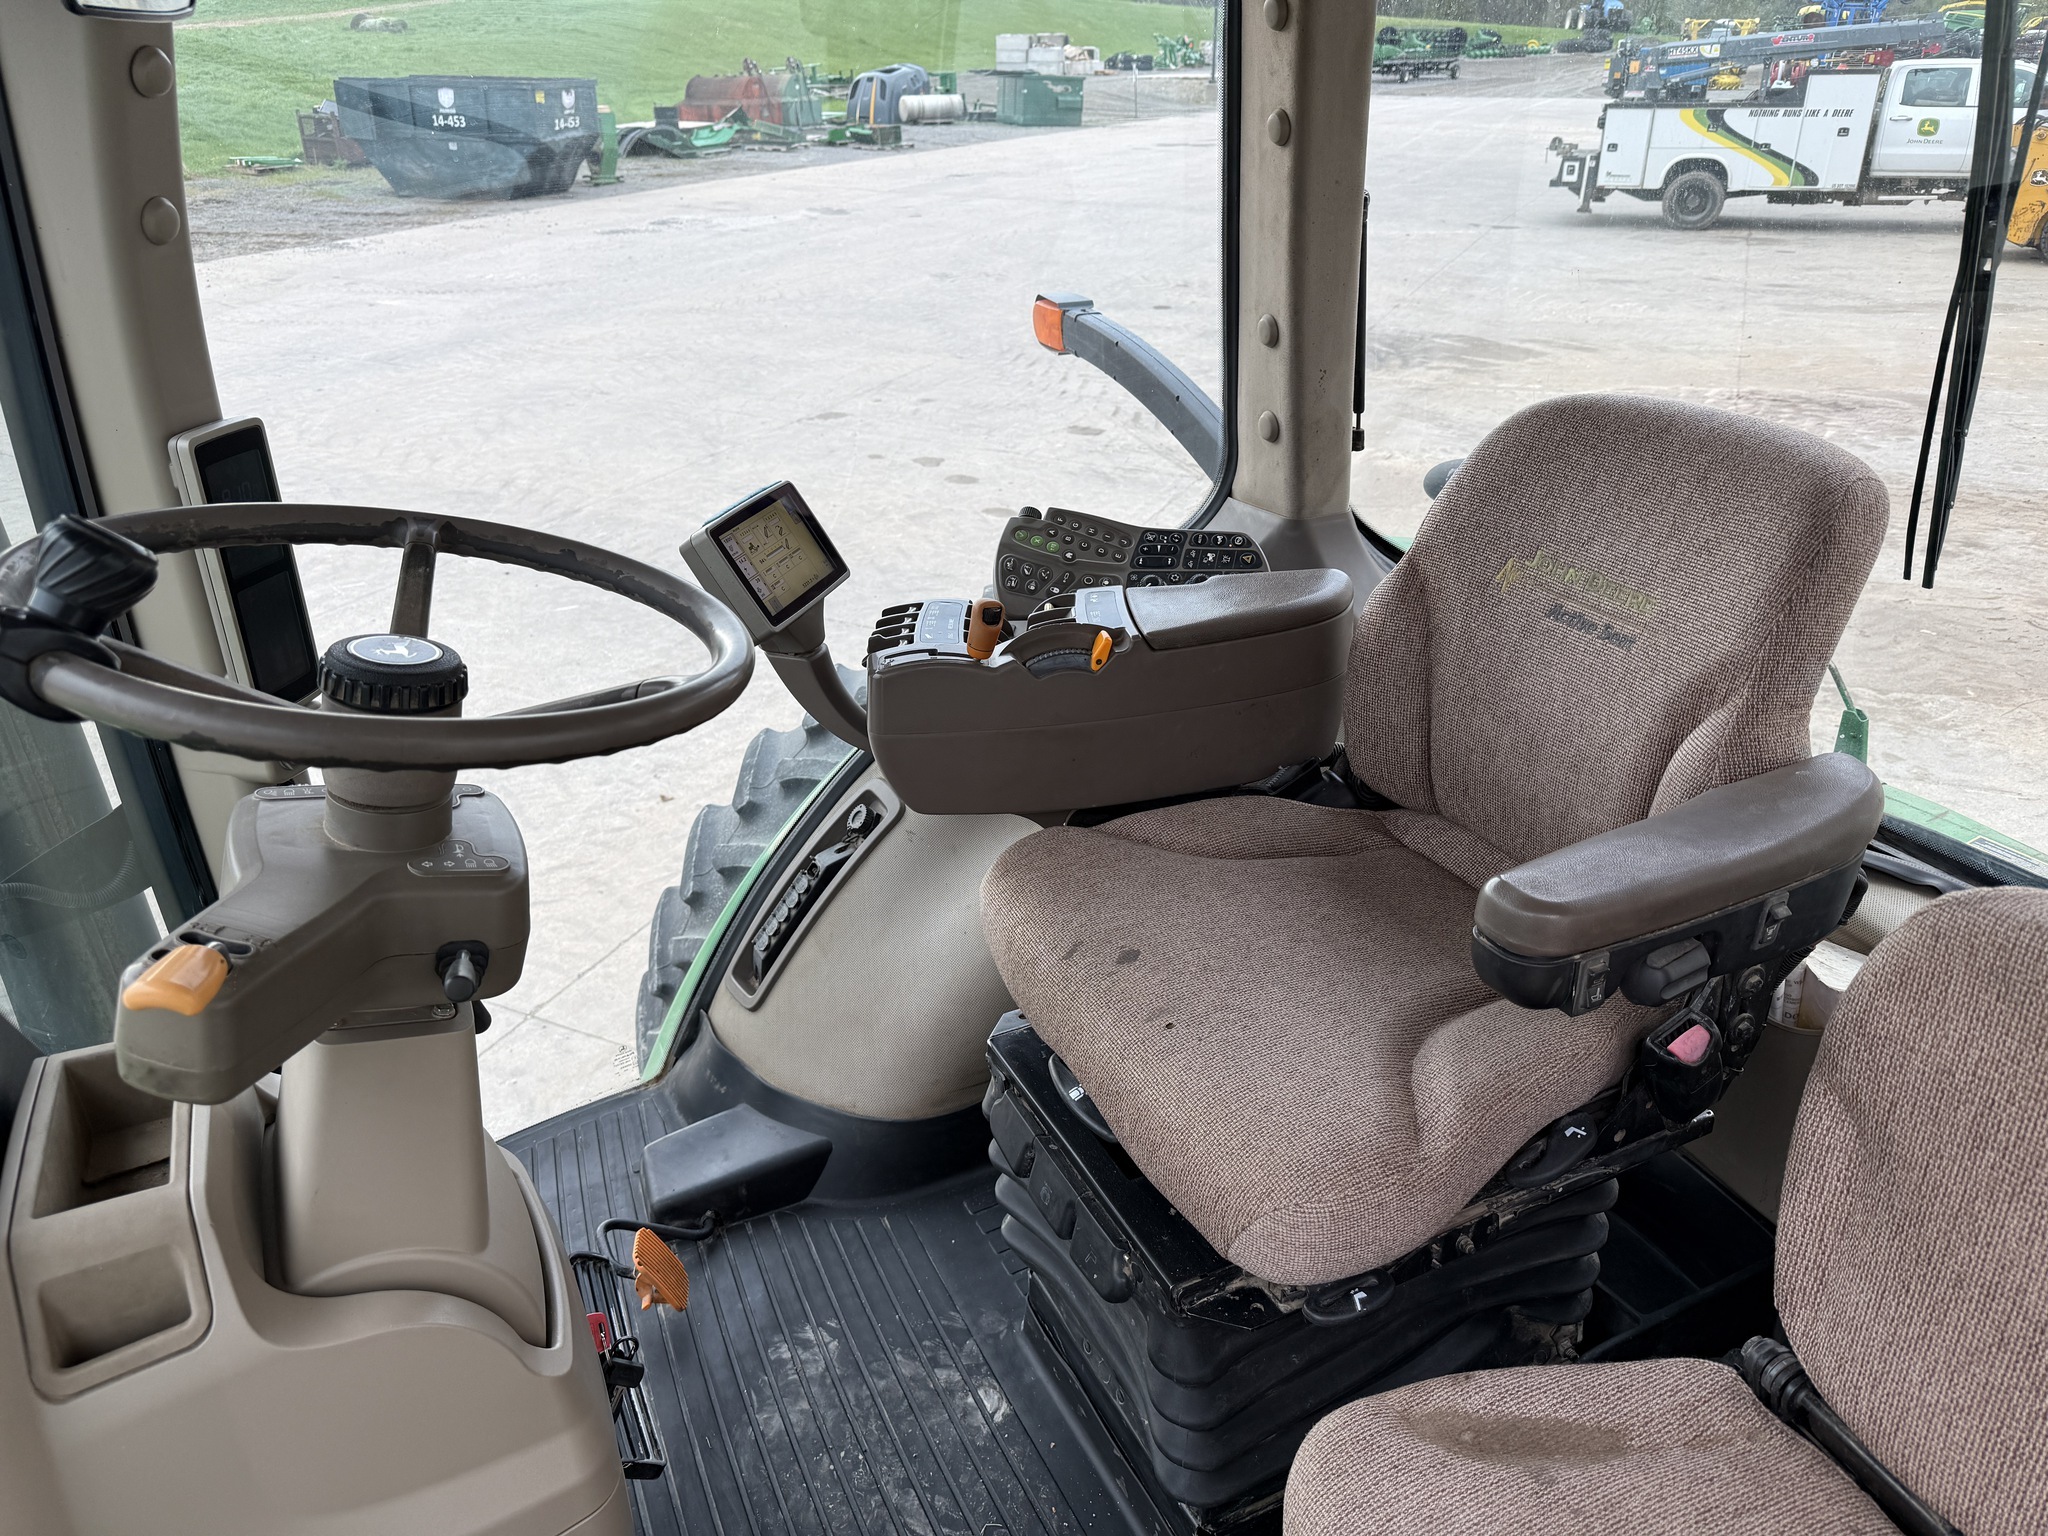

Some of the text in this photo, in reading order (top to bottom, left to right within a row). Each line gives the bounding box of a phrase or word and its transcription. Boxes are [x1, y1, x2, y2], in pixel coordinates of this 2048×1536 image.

[432, 114, 466, 127] 14-453
[1748, 109, 1854, 118] NOTHING RUNS LIKE A DEERE
[1525, 550, 1657, 613] JOHN DEERE
[1546, 603, 1637, 651] Active Seat
